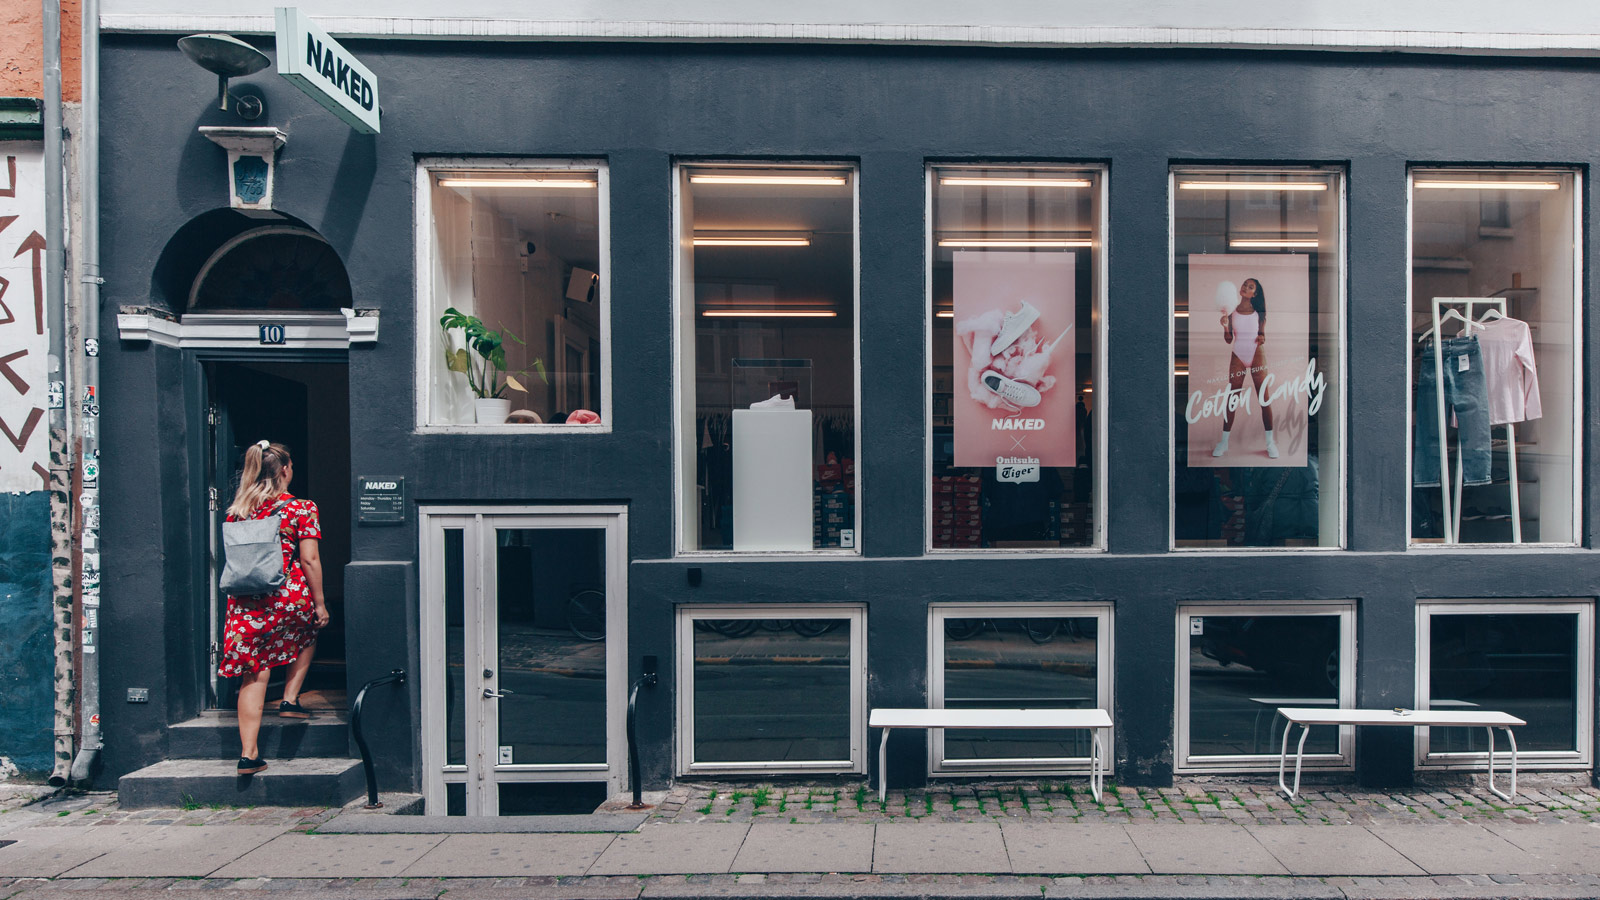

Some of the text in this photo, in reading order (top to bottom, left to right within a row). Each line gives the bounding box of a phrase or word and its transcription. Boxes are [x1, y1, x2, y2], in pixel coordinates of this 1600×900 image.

[307, 32, 374, 112] NAKED
[263, 327, 281, 342] 10
[1185, 357, 1327, 424] Cotton Candy
[991, 418, 1045, 430] NAKED
[996, 456, 1040, 464] Onitsuka
[1002, 467, 1034, 479] Tiger
[365, 482, 397, 490] NAKED
